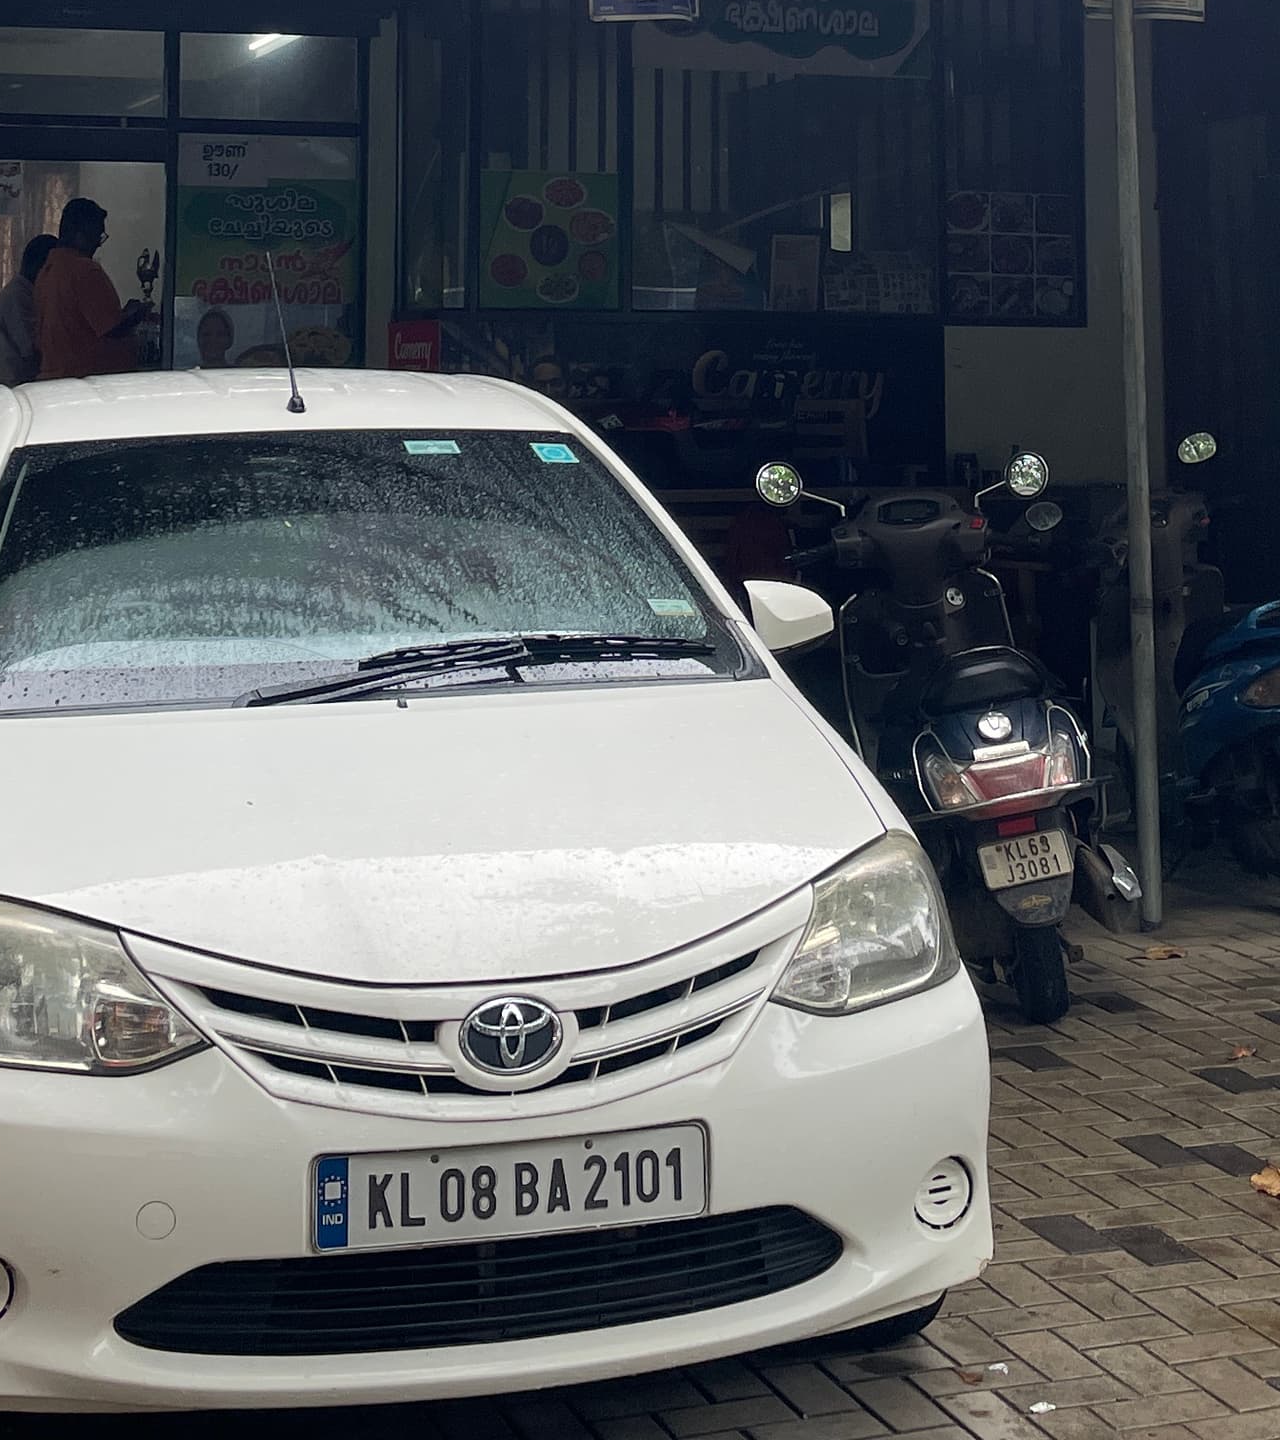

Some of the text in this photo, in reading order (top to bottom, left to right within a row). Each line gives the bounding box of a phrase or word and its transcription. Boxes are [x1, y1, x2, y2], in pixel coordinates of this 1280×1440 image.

[225, 187, 318, 213] സുശീല
[208, 214, 335, 240] ചേച്ചിയുടെ
[1007, 853, 1062, 883] J3081
[368, 1147, 683, 1230] KL 08 BA 2101
[322, 1213, 344, 1226] IND
